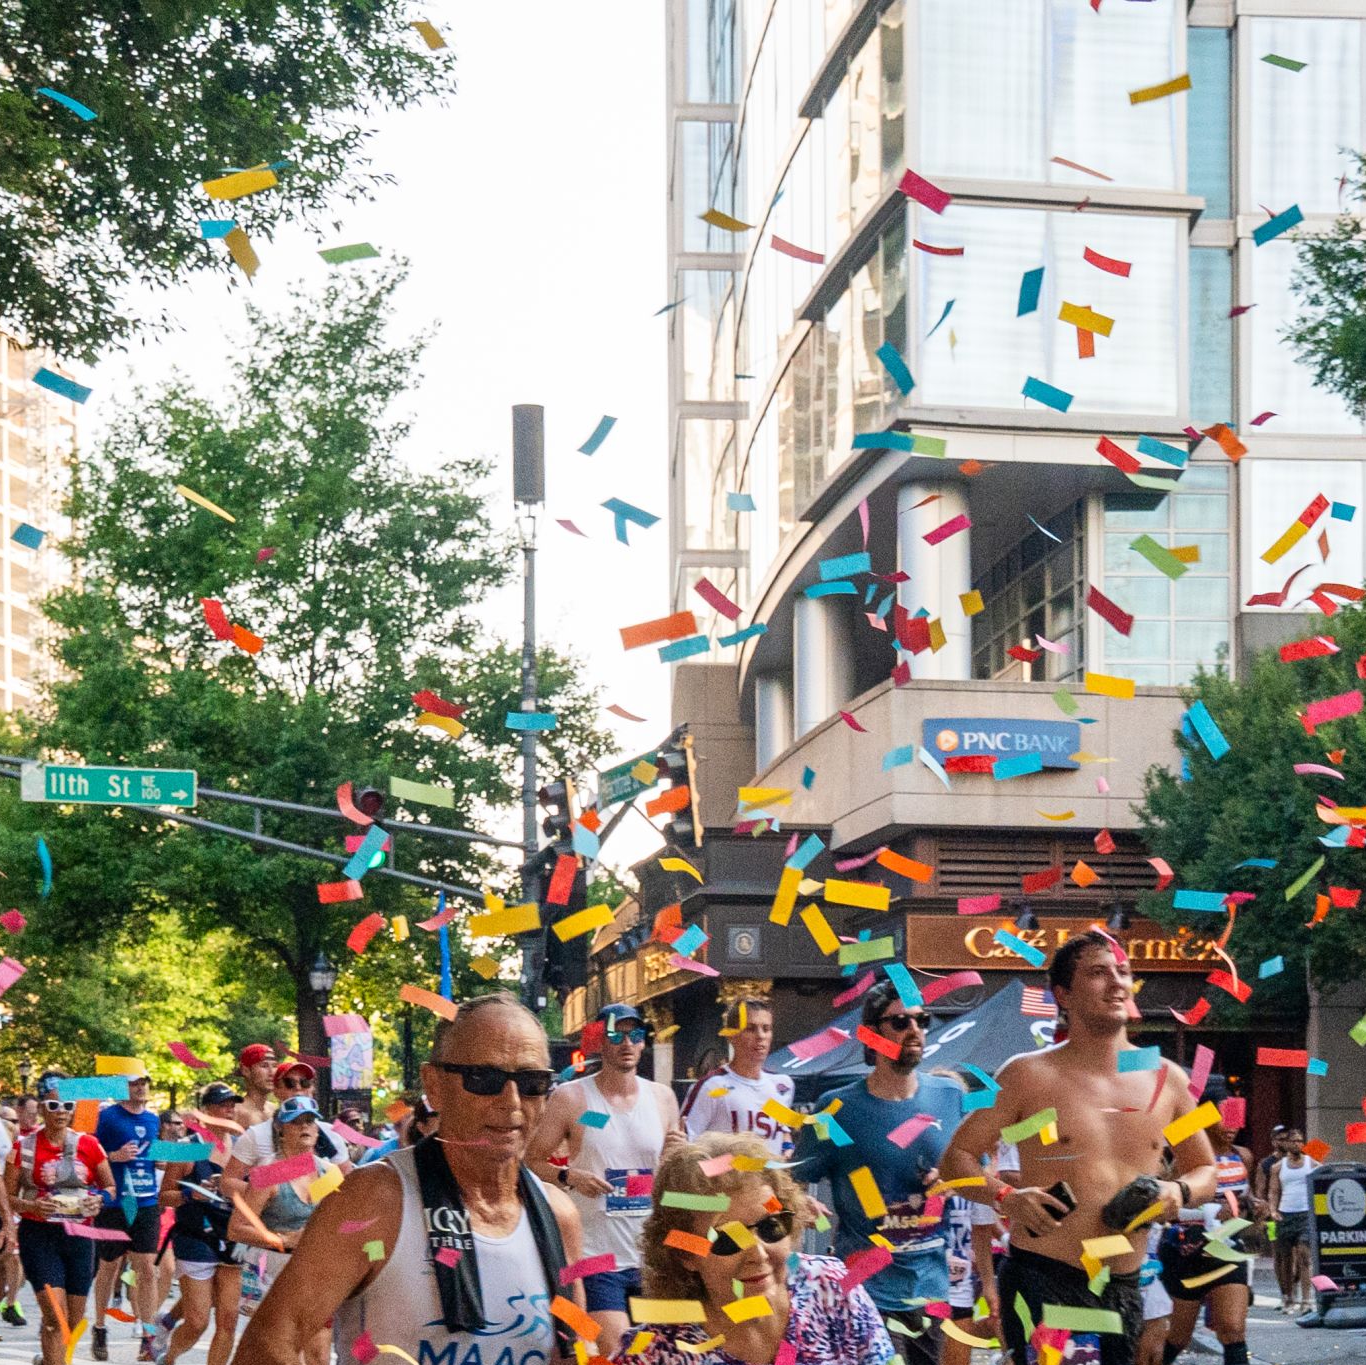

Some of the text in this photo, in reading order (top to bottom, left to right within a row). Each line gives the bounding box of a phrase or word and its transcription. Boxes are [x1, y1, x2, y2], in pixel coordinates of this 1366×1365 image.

[963, 732, 1071, 753] PNC BANK
[50, 773, 131, 798] 11th St
[141, 775, 156, 788] NE
[141, 788, 161, 800] 100
